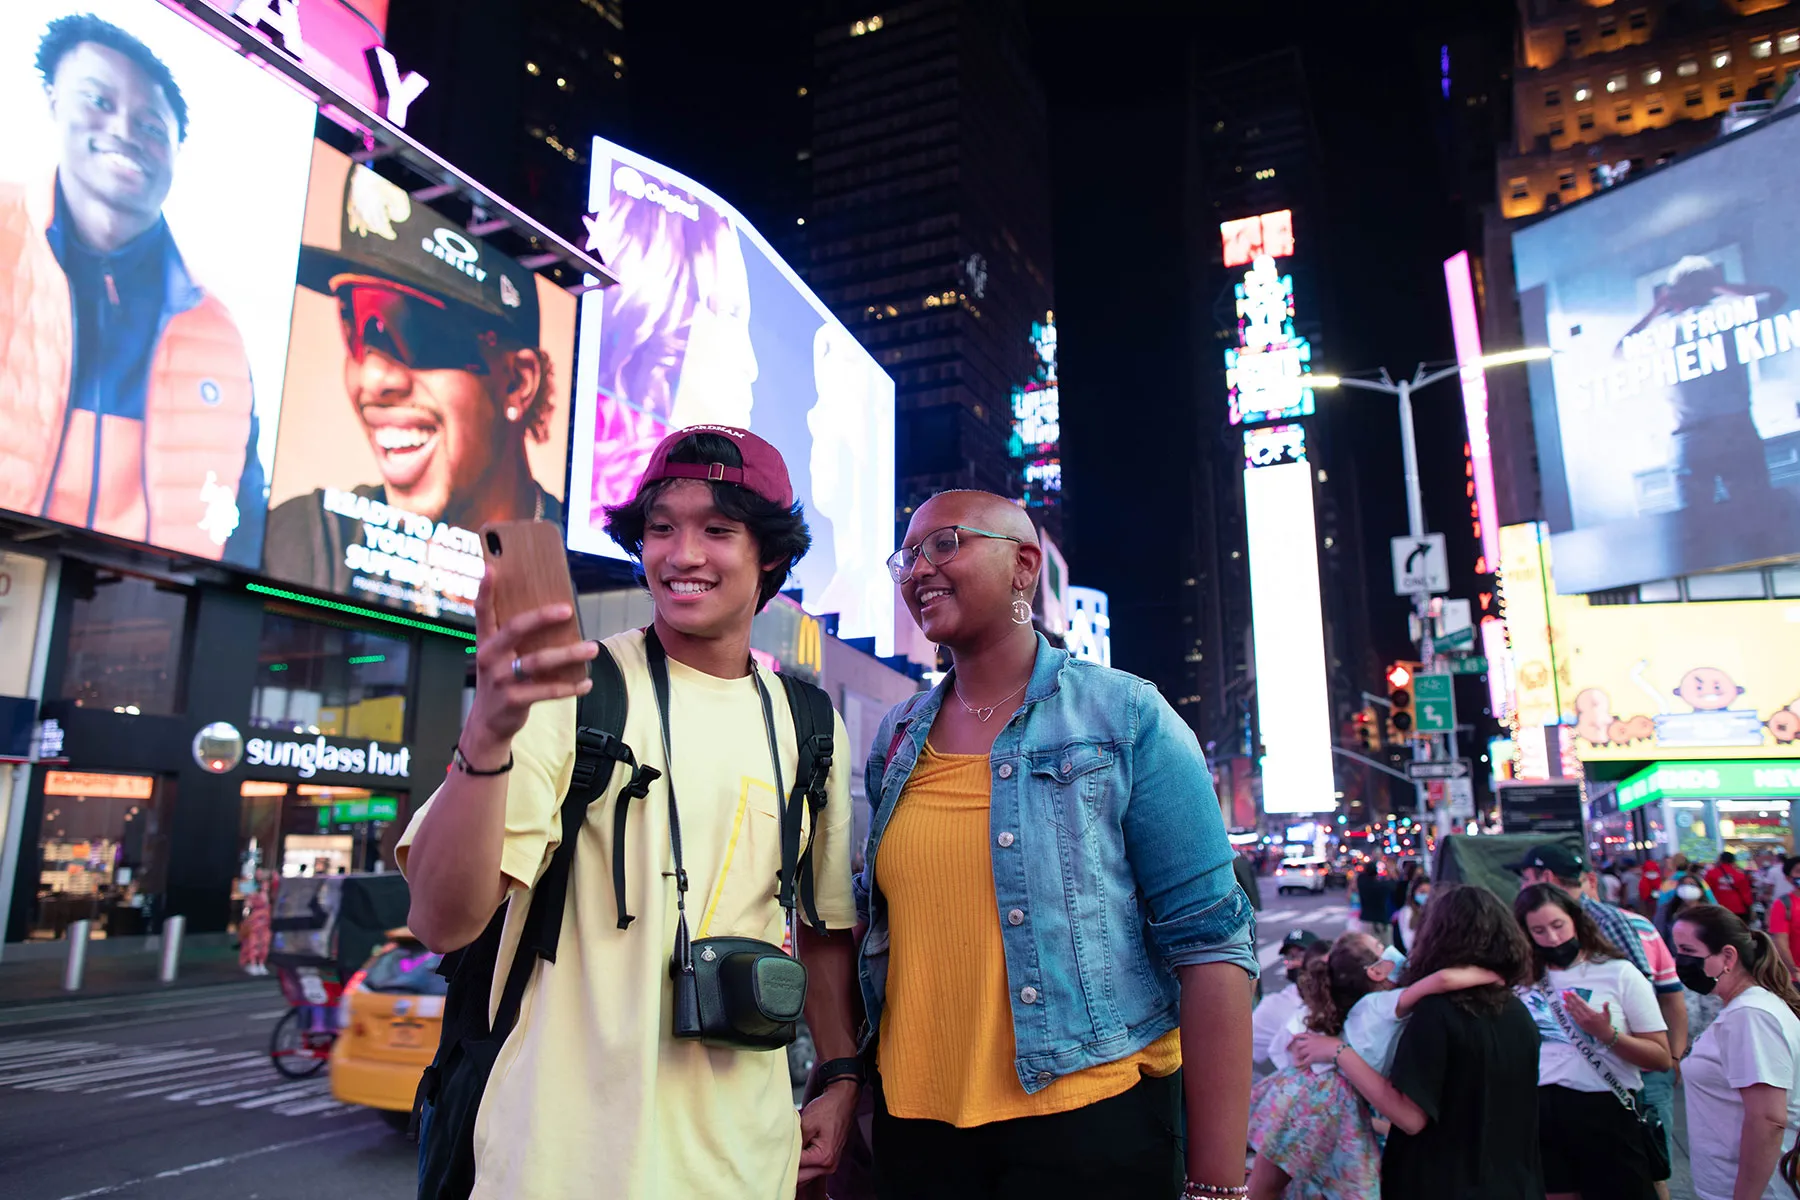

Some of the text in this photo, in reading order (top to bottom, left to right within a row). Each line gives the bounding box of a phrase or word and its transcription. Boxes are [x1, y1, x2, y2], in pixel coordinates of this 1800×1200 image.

[1682, 295, 1758, 342] FROM
[246, 736, 411, 778] sunglass hut
